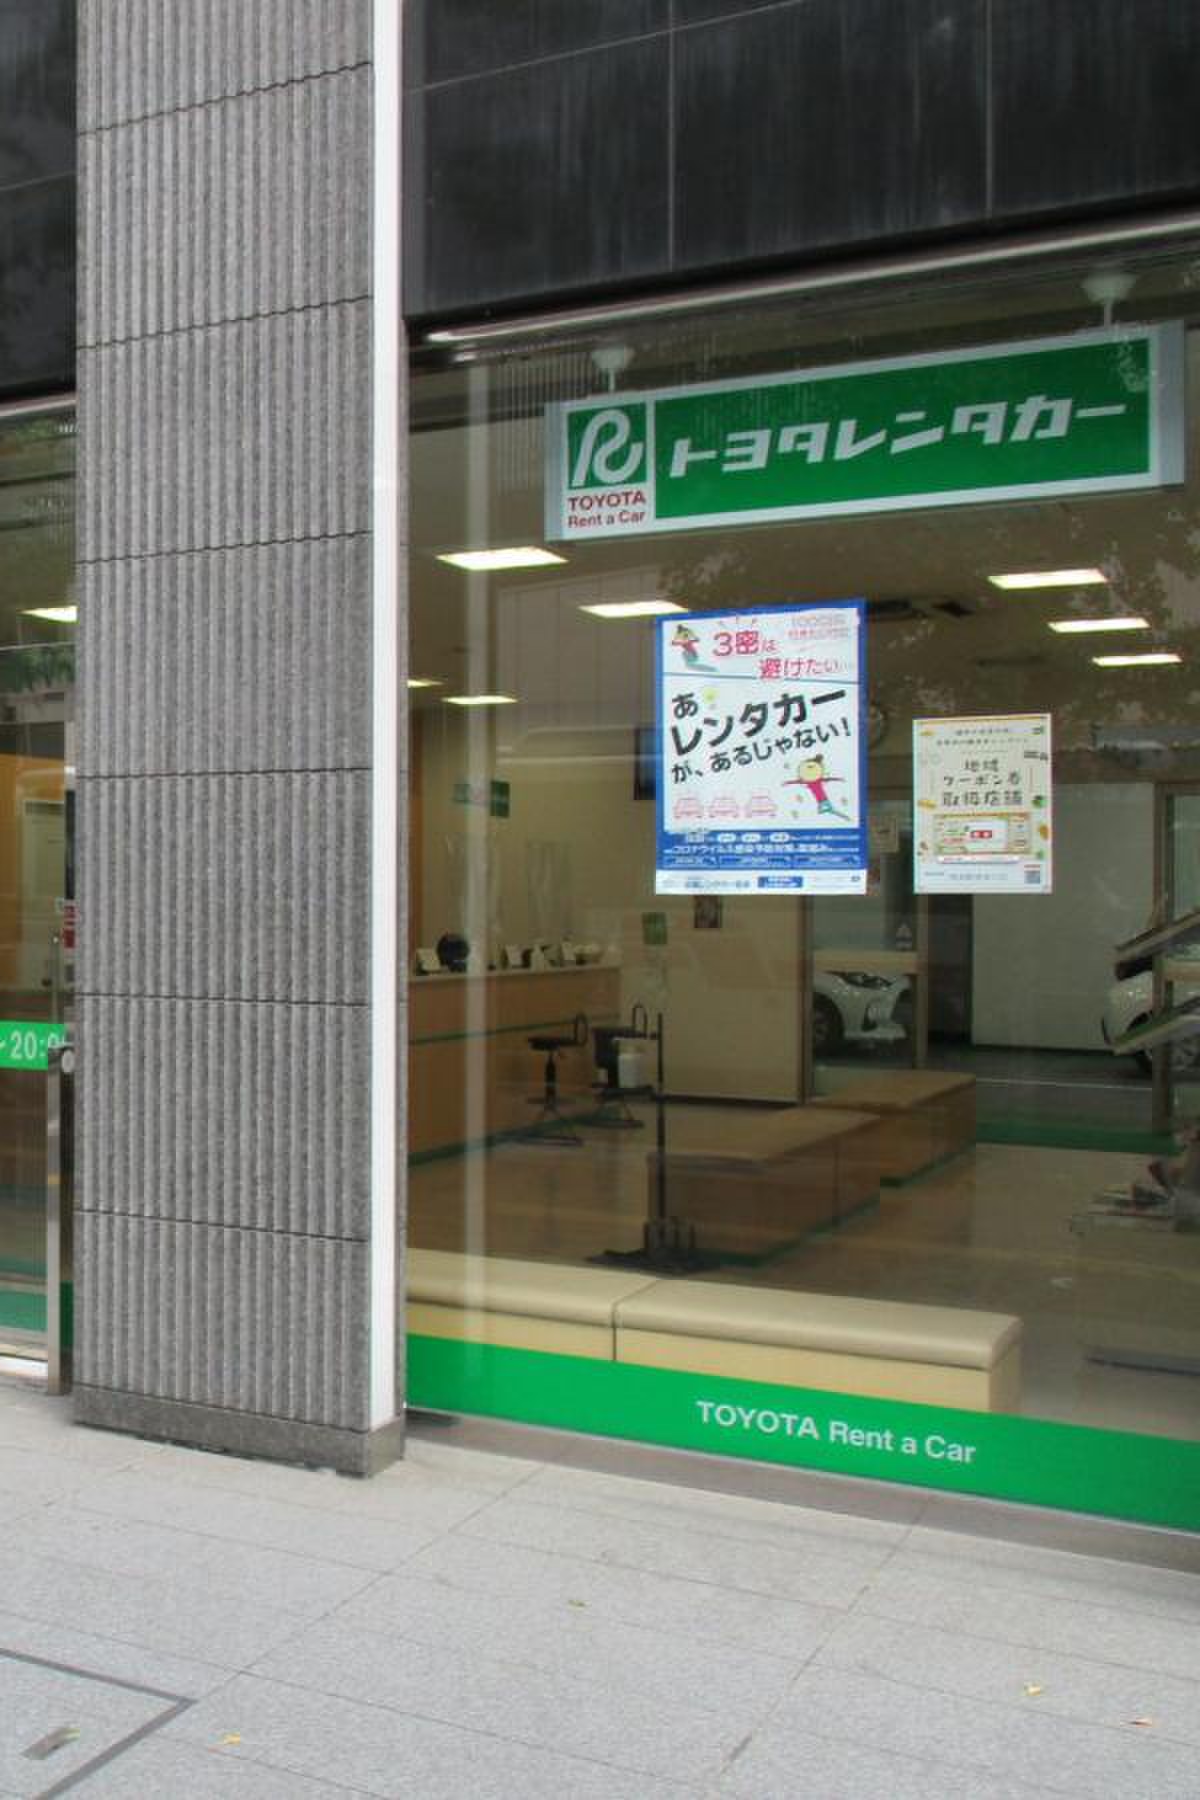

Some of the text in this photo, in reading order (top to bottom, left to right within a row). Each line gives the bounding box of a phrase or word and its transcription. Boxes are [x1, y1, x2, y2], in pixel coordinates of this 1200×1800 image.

[669, 395, 1127, 478] トヨタレンタカー
[568, 490, 646, 511] TOYOTA
[568, 510, 646, 529] Rent a Car
[671, 689, 846, 757] レンタカー
[672, 692, 699, 720] あ
[696, 1401, 977, 1464] TOYOTA Rent a Car
